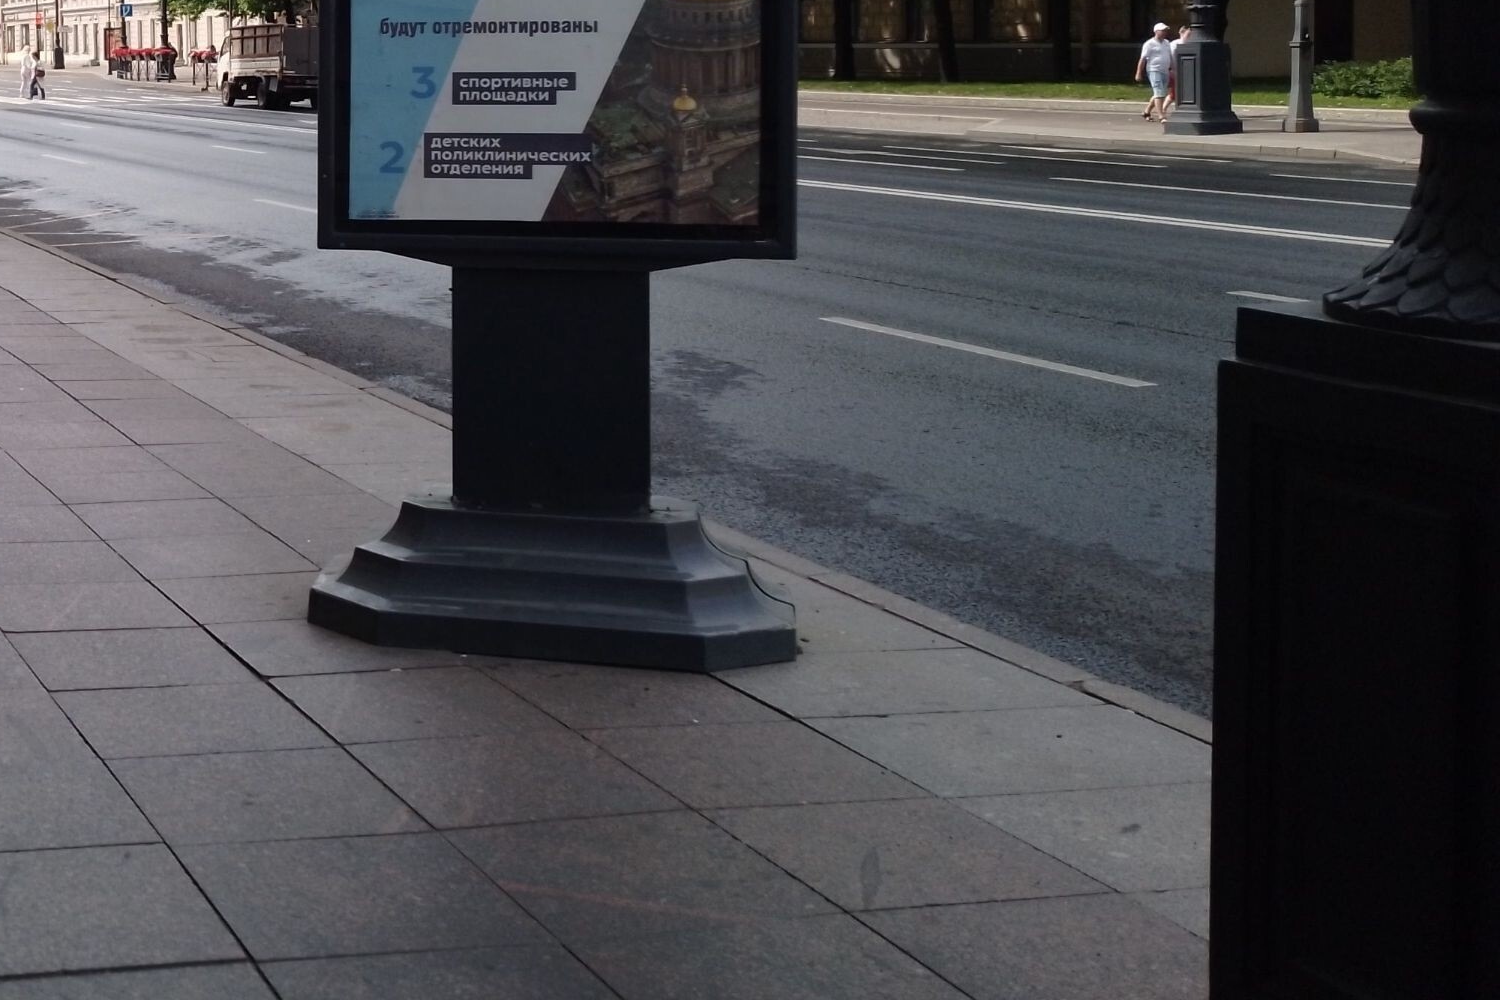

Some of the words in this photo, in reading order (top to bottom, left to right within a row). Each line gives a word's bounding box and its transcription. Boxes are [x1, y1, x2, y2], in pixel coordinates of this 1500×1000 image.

[379, 17, 428, 38] будут
[432, 18, 599, 37] отремонтированы
[411, 66, 436, 99] 3
[458, 76, 569, 90] спортивные
[458, 89, 550, 104] площадки
[430, 134, 502, 150] детских
[379, 141, 405, 174] 2
[430, 148, 592, 164] поликлинических
[430, 162, 525, 177] отделения
